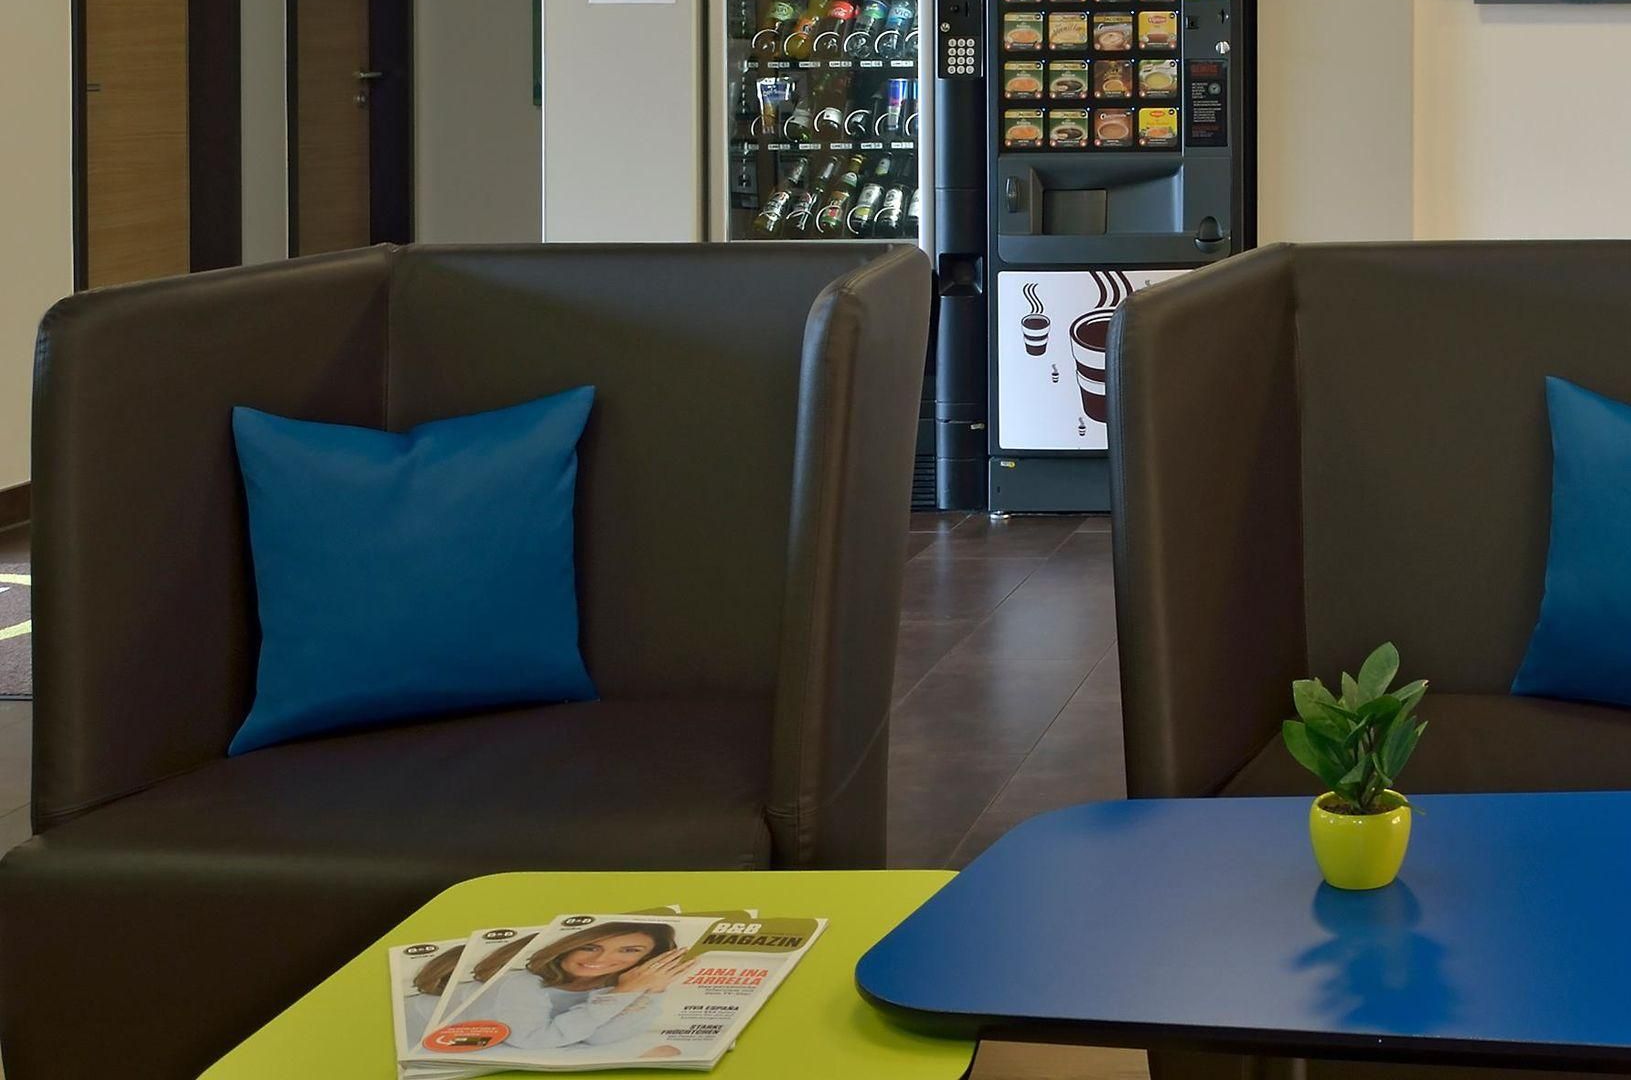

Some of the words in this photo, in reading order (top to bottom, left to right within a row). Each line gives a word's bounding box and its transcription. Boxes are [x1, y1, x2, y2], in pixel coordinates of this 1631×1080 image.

[713, 922, 762, 934] B&B
[702, 934, 803, 948] MAGAZIN
[696, 967, 737, 976] JANA
[739, 968, 769, 977] INA
[682, 976, 763, 987] ZARRELLA
